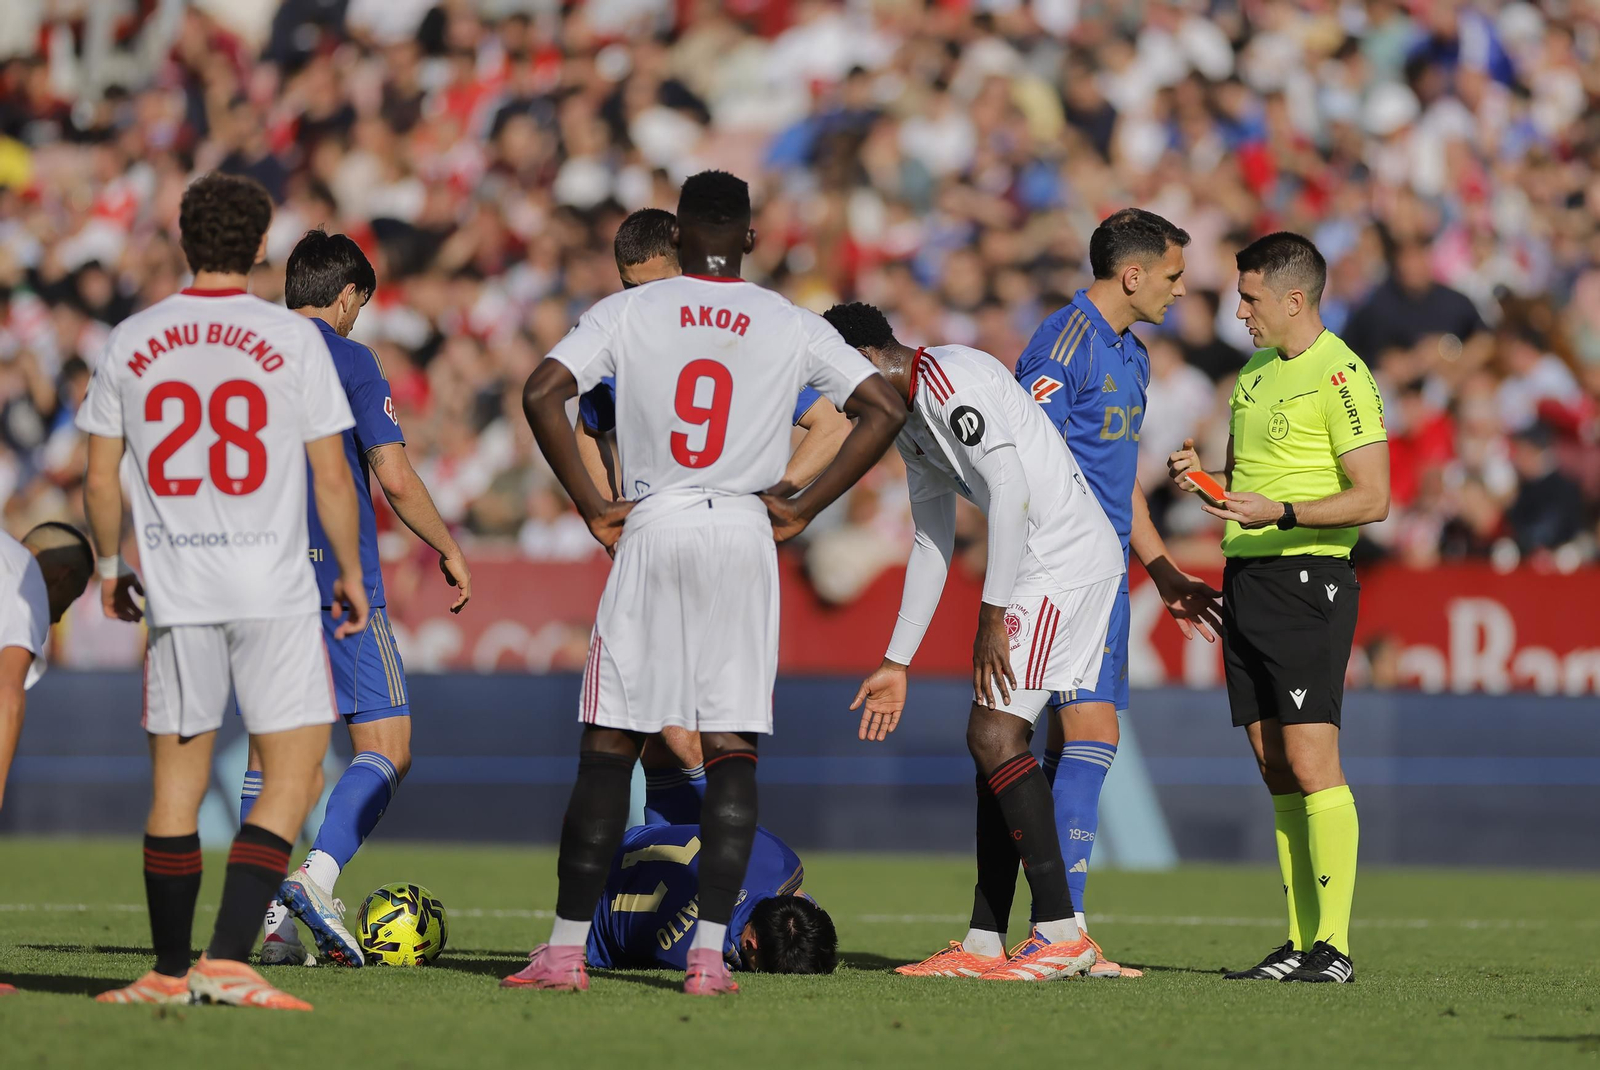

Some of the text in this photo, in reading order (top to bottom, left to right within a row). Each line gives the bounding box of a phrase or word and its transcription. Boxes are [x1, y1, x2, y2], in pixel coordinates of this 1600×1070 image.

[680, 305, 751, 337] AKOR
[127, 323, 284, 377] MANU BUENO
[144, 379, 268, 497] 28
[670, 358, 734, 469] 9
[1338, 385, 1364, 437] WÜRTH
[1069, 828, 1095, 842] 1926
[656, 893, 699, 951] ATTO
